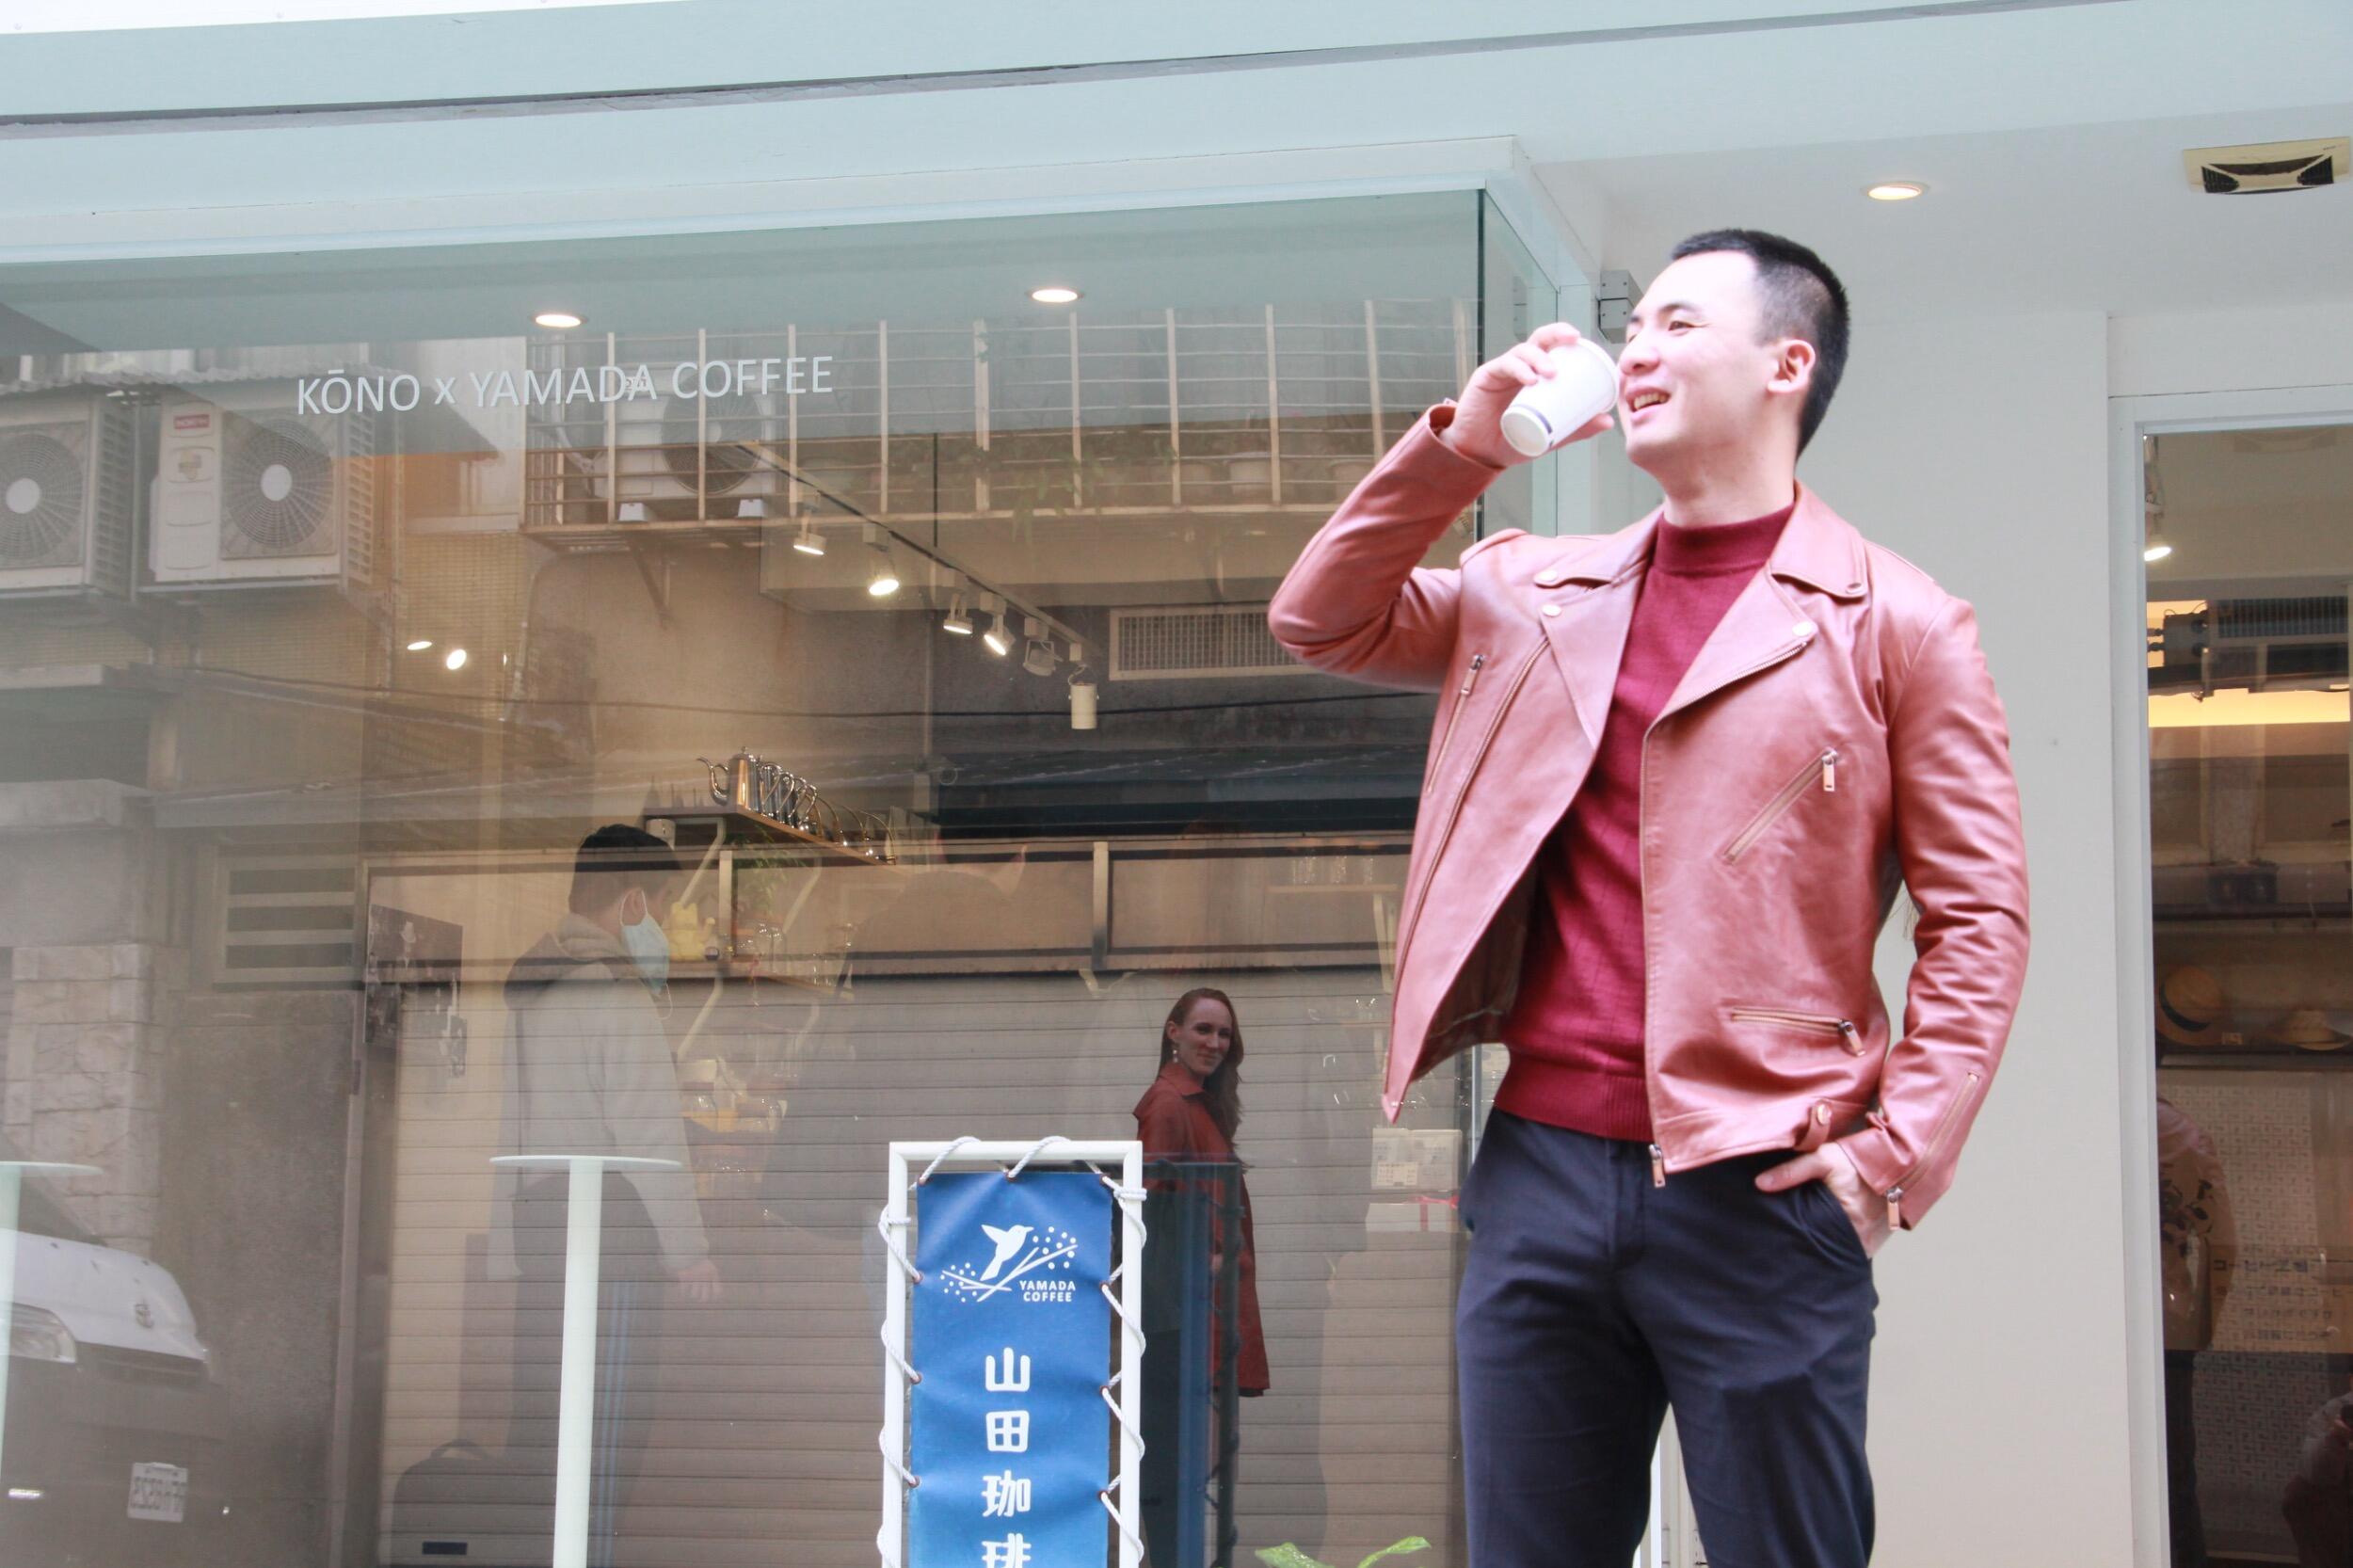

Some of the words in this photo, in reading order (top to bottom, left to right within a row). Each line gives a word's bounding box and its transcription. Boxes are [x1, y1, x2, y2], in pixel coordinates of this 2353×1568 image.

[297, 368, 421, 415] KŌNO
[470, 365, 658, 408] YAMADA
[672, 355, 834, 399] COFFEE
[1019, 1280, 1076, 1291] YAMADA
[1023, 1291, 1072, 1303] COFFEE
